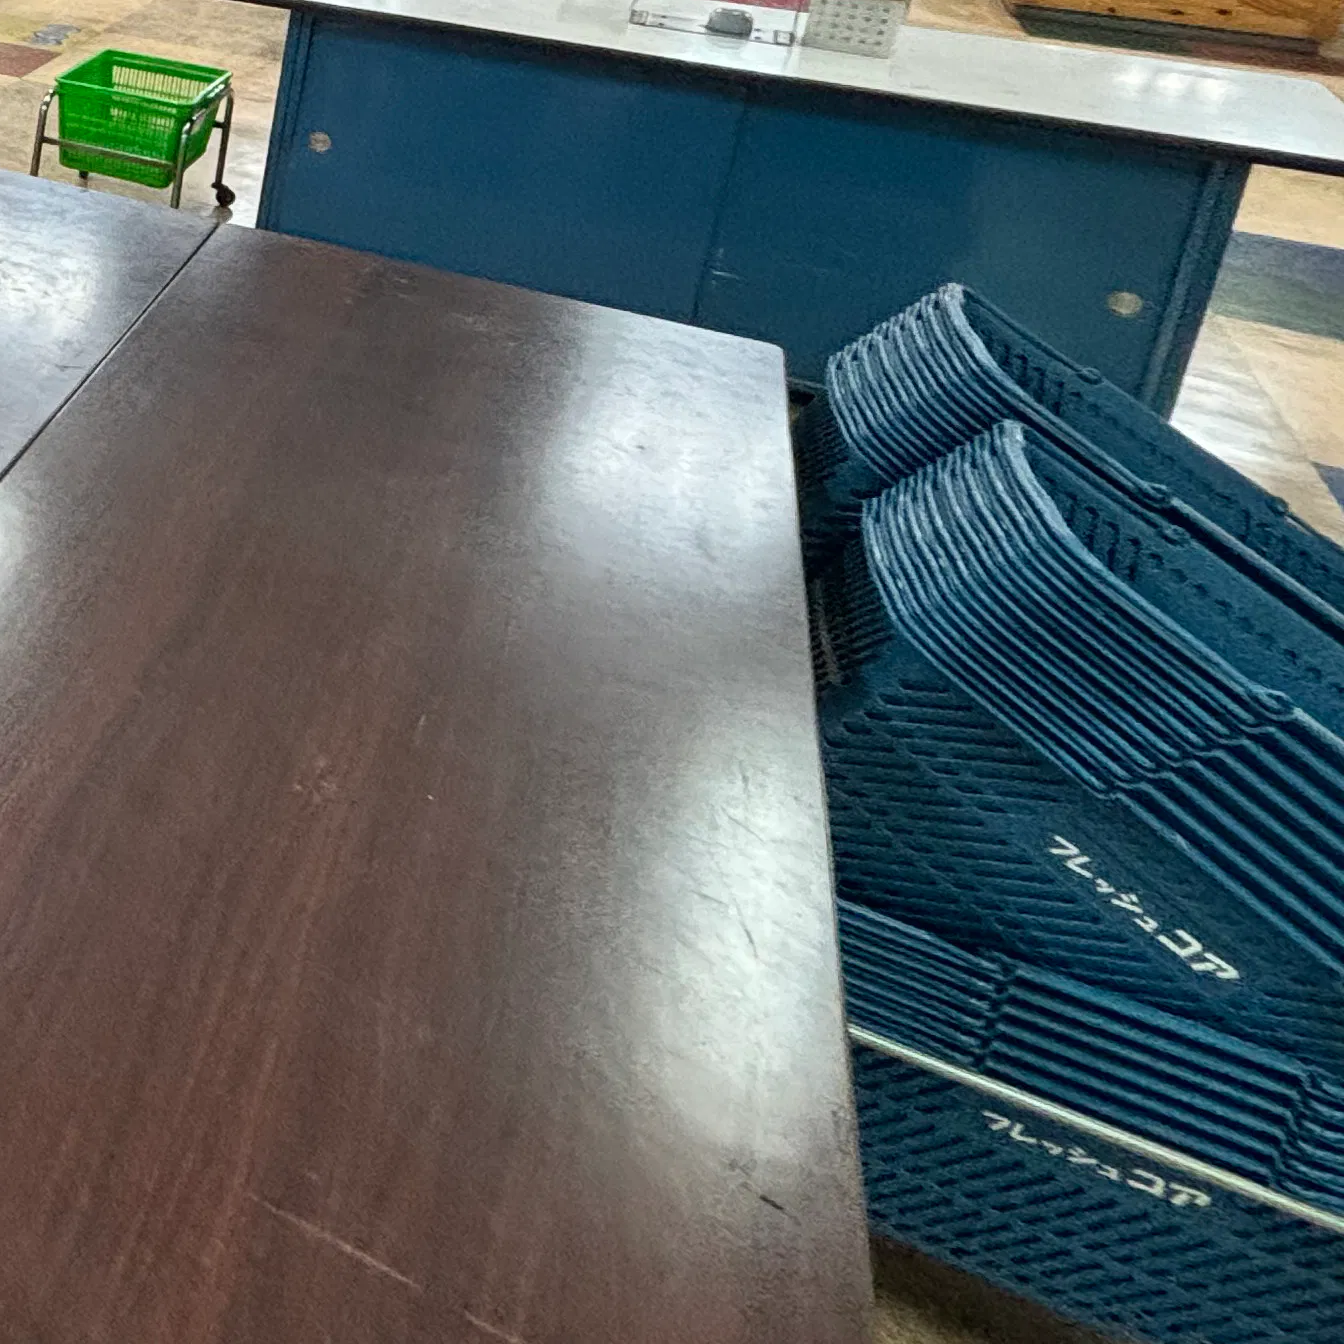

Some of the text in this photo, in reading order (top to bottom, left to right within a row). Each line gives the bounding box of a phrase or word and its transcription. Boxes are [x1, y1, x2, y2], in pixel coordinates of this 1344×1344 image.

[1049, 834, 1239, 979] フレッシュコア
[981, 1110, 1211, 1206] フレッシュコア
